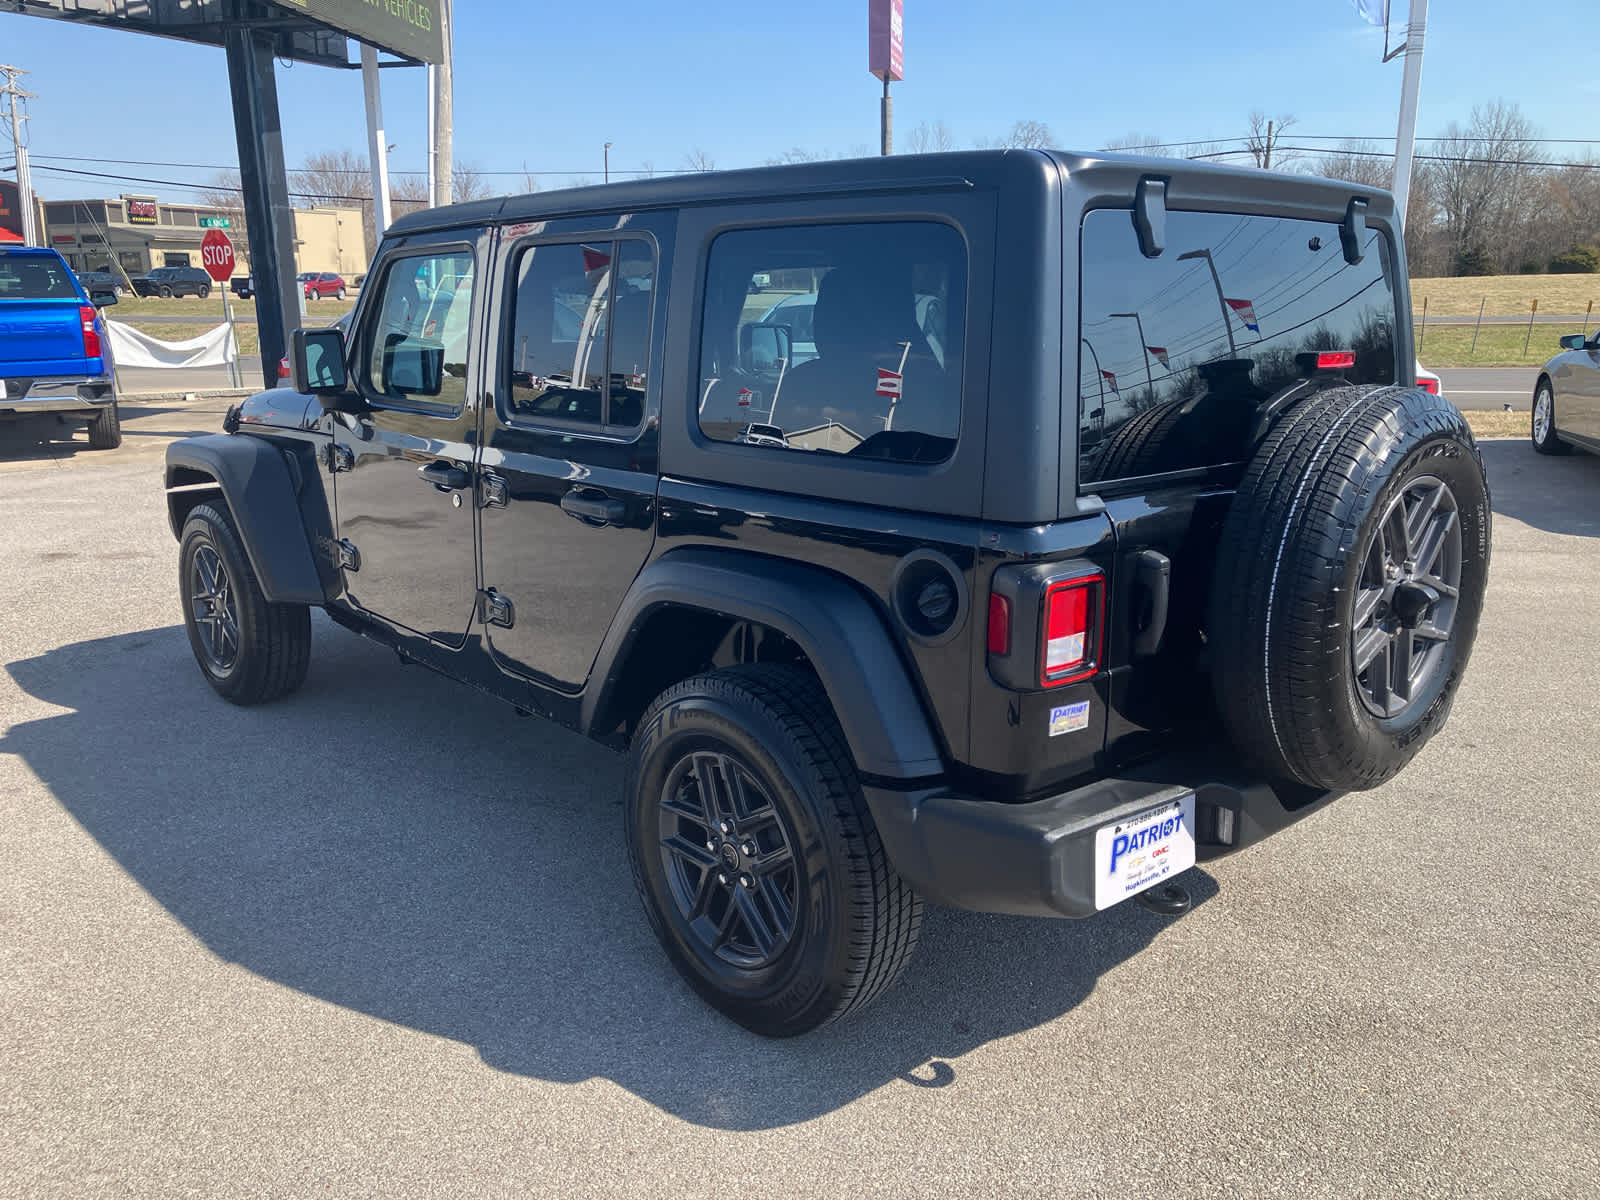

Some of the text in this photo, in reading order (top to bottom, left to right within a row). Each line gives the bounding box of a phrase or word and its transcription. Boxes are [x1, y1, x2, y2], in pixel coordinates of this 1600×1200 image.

[203, 245, 232, 265] STOP
[1051, 703, 1088, 724] PATRIOT
[1110, 813, 1185, 873] PATRIOT
[1152, 845, 1169, 858] GMC
